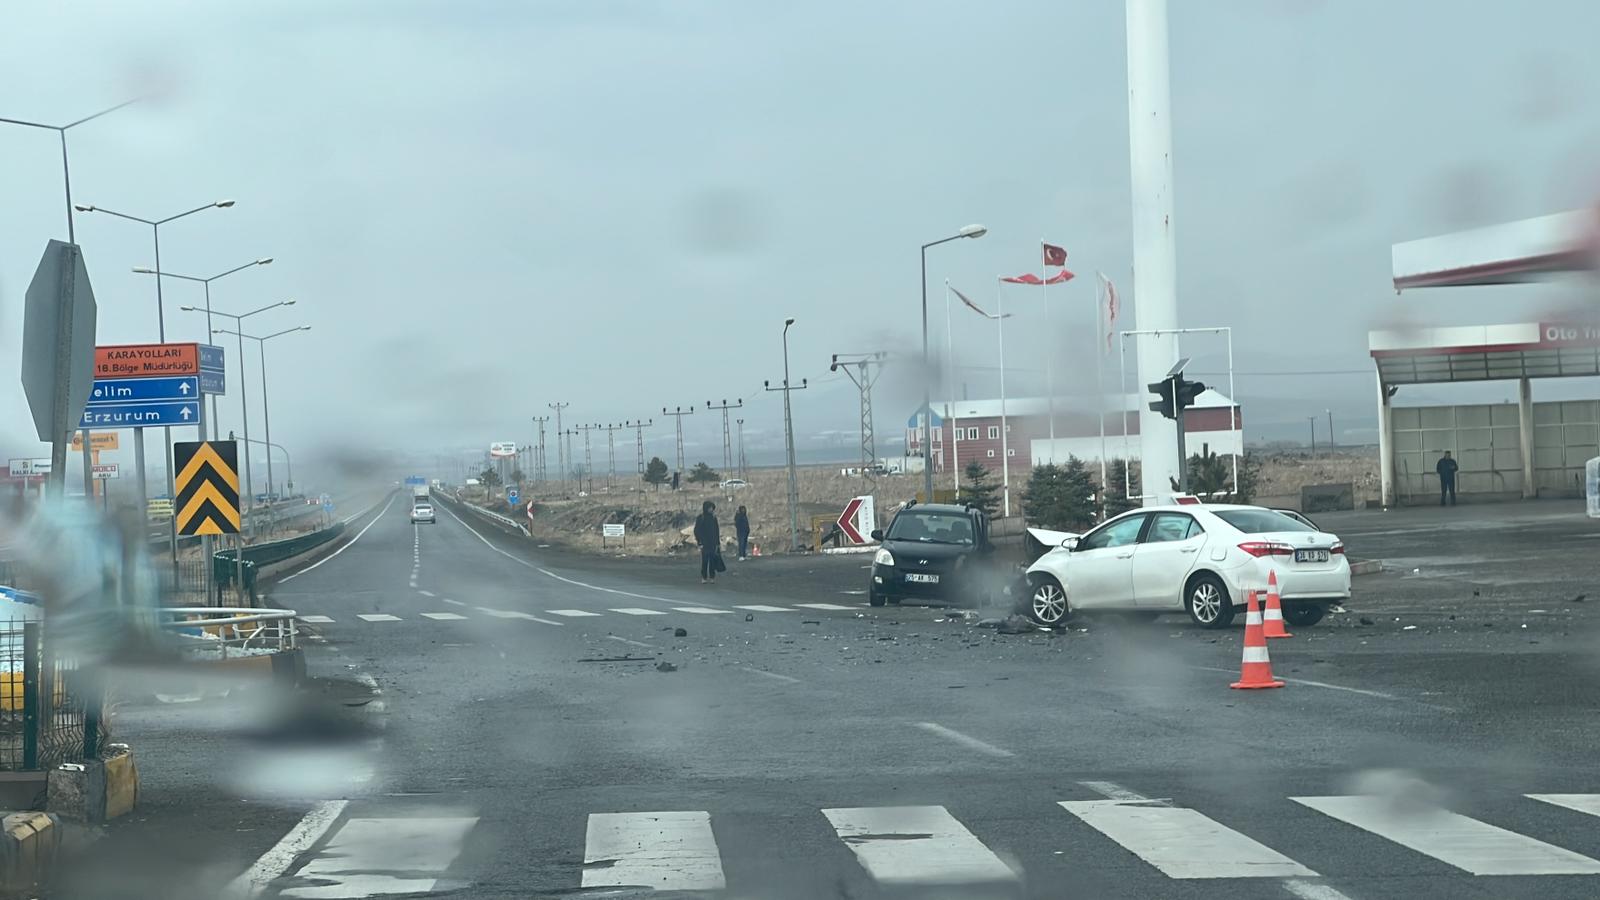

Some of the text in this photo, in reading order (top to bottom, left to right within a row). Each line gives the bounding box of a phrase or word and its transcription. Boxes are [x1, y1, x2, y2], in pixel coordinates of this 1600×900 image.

[107, 349, 182, 360] KARAYOLLARI
[143, 361, 193, 372] Müdürlüğü
[93, 385, 133, 398] elim
[83, 410, 160, 423] Erzurum
